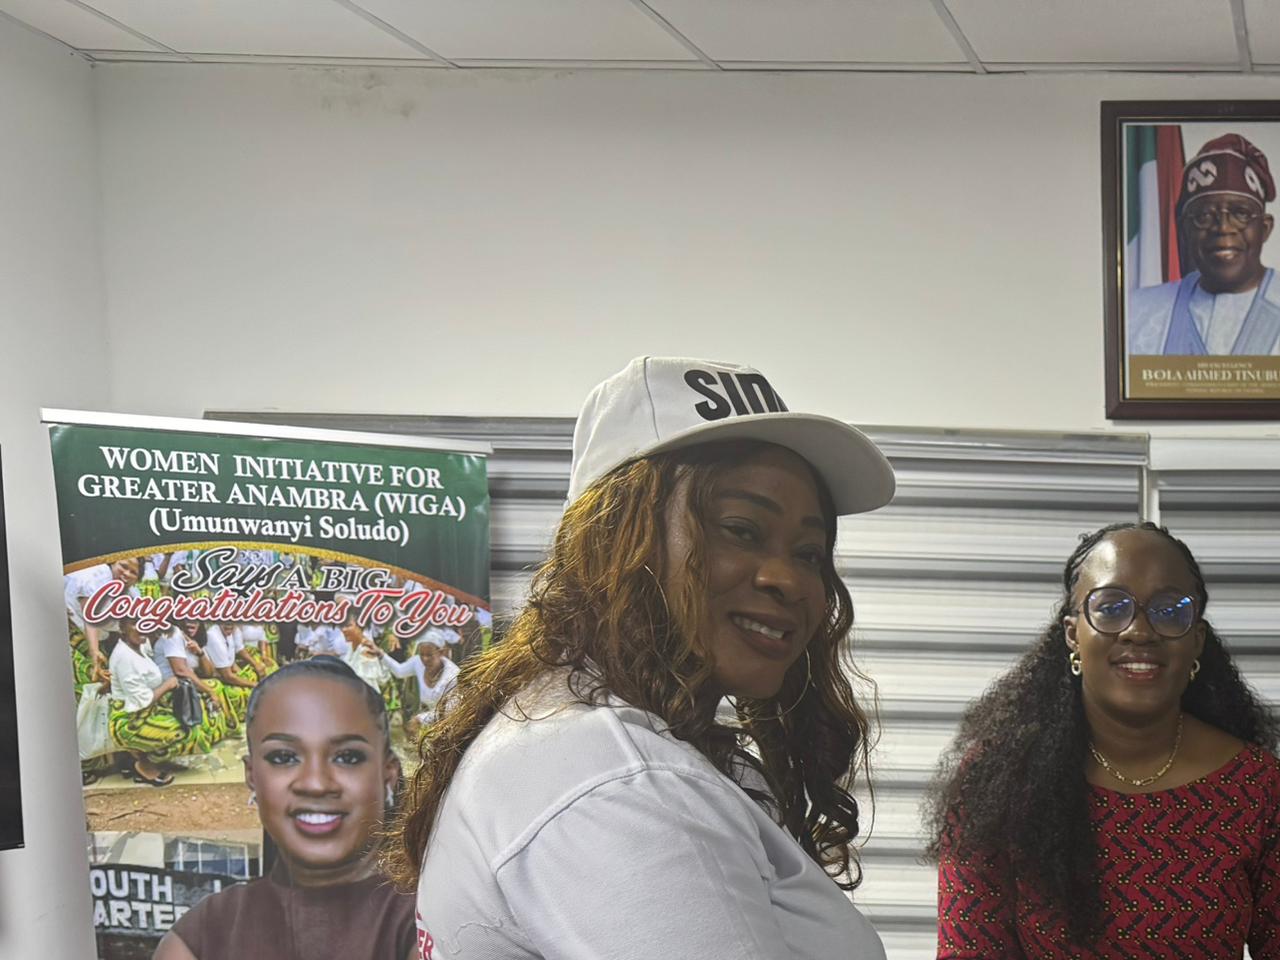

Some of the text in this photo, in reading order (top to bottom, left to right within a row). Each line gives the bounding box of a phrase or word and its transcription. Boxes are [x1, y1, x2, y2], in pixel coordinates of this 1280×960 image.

[1142, 370, 1182, 381] BOLA
[1184, 370, 1232, 381] AHMED
[99, 446, 444, 489] WOMEN INITIATIVE FOR
[78, 474, 466, 521] GREATER ANAMBRA (WIGA)
[149, 507, 410, 546] (Umunwanyi Soludo)
[173, 546, 390, 598] Says A BIG
[83, 580, 474, 638] Congratulations To You
